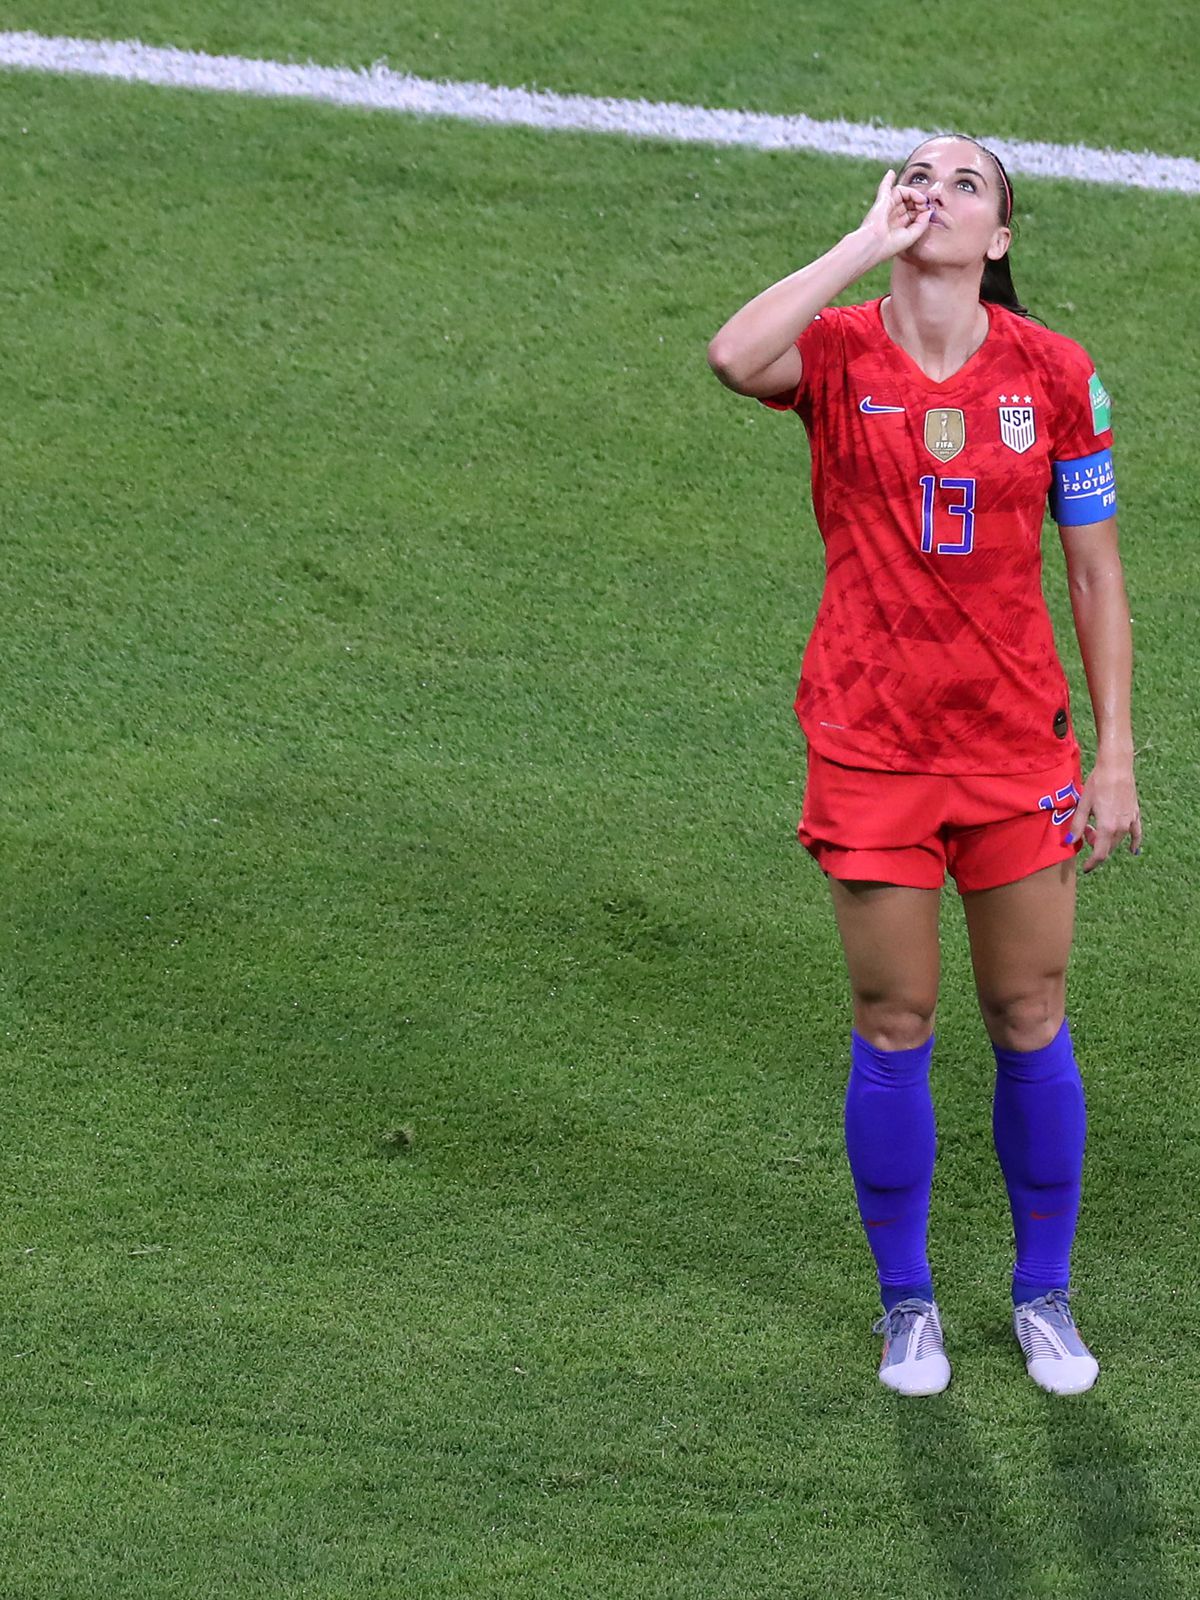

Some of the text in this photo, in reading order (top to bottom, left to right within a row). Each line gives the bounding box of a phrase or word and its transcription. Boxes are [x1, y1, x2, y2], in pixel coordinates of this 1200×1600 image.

[1002, 410, 1031, 426] USA
[935, 441, 953, 449] FIFA
[919, 475, 976, 555] 13
